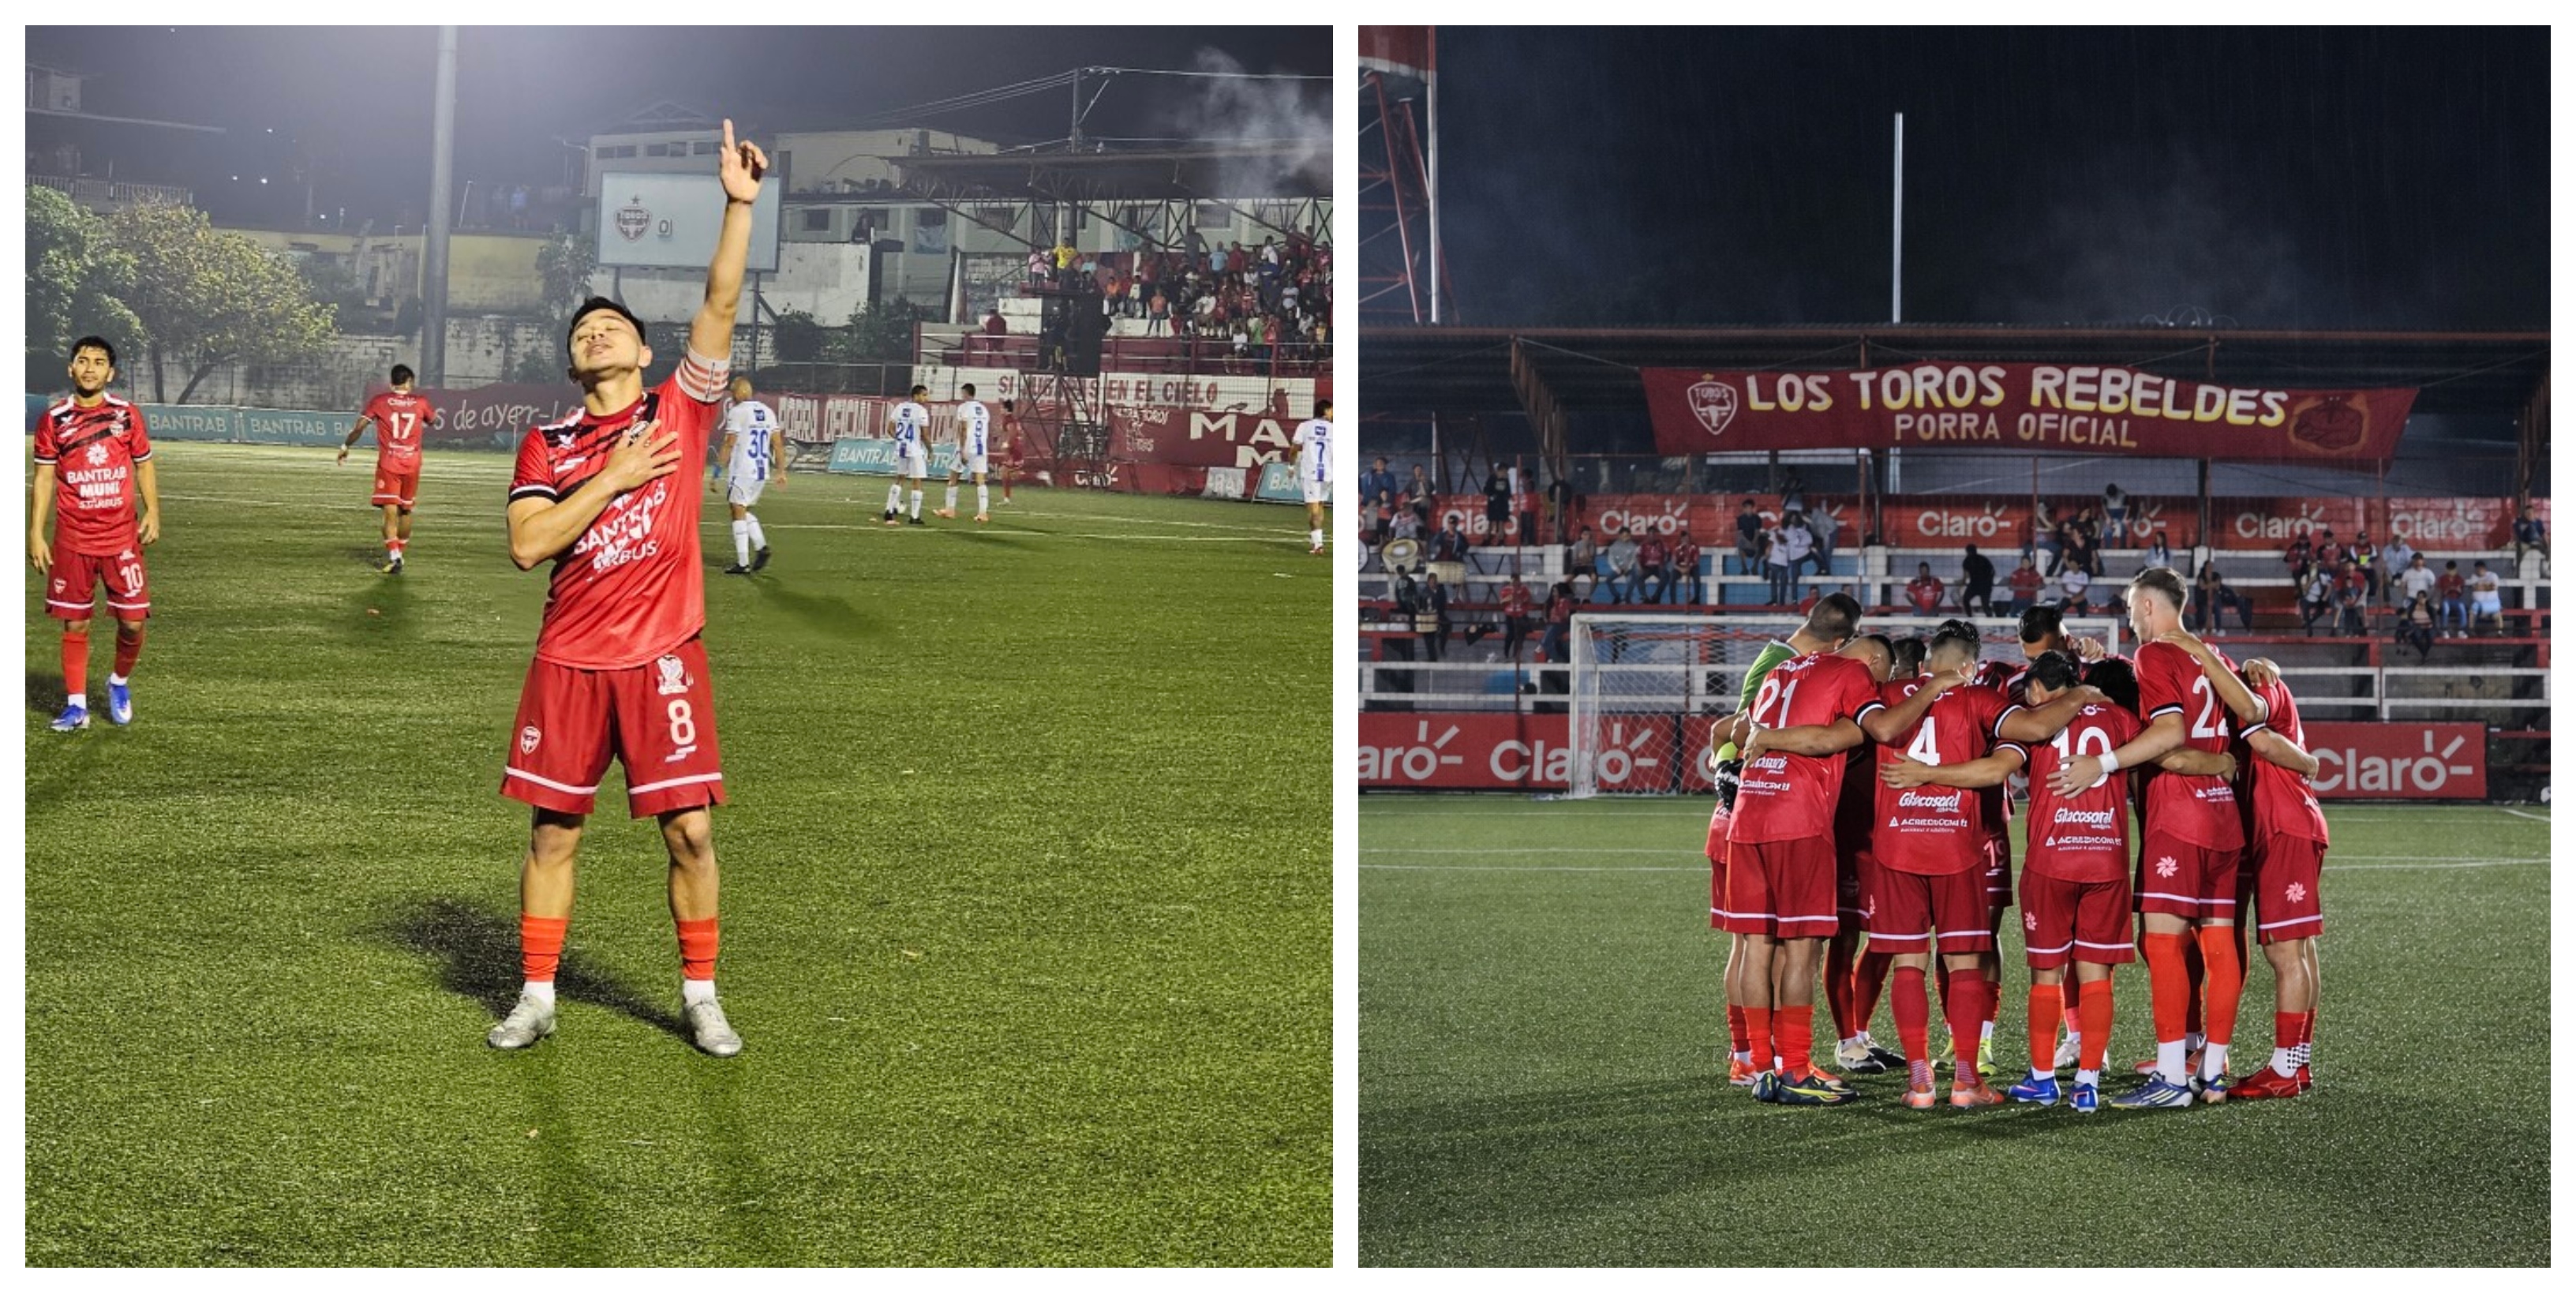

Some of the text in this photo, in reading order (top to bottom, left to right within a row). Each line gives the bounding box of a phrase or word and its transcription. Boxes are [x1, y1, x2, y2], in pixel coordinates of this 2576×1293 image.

[998, 376, 1014, 395] SI
[1106, 380, 1129, 400] EN
[1134, 380, 1155, 402] EL
[1162, 380, 1218, 403] CIELO
[1747, 365, 2289, 427] LOS TOROS REBELDES
[149, 414, 227, 433] BANTRAB
[250, 418, 327, 436] BANTRAB
[390, 412, 416, 439] 17
[453, 399, 477, 430] de
[747, 429, 769, 458] 30
[895, 422, 915, 442] 24
[1895, 412, 2138, 448] PORRA OFICIAL
[1316, 441, 1325, 463] 7
[66, 467, 126, 484] BANTRAB
[80, 481, 120, 498] MUNI
[1442, 509, 1518, 535] Clao
[1600, 510, 1678, 536] Claro
[1917, 510, 1998, 538] Claro
[2236, 512, 2315, 539] Claro
[2391, 511, 2471, 540] Claro
[120, 563, 144, 591] 10
[1752, 678, 1799, 729] 21
[667, 699, 697, 745] 8
[1907, 715, 1941, 766] 4
[2050, 725, 2112, 788] 10
[2310, 747, 2447, 791] Claro
[1983, 839, 2007, 868] 19
